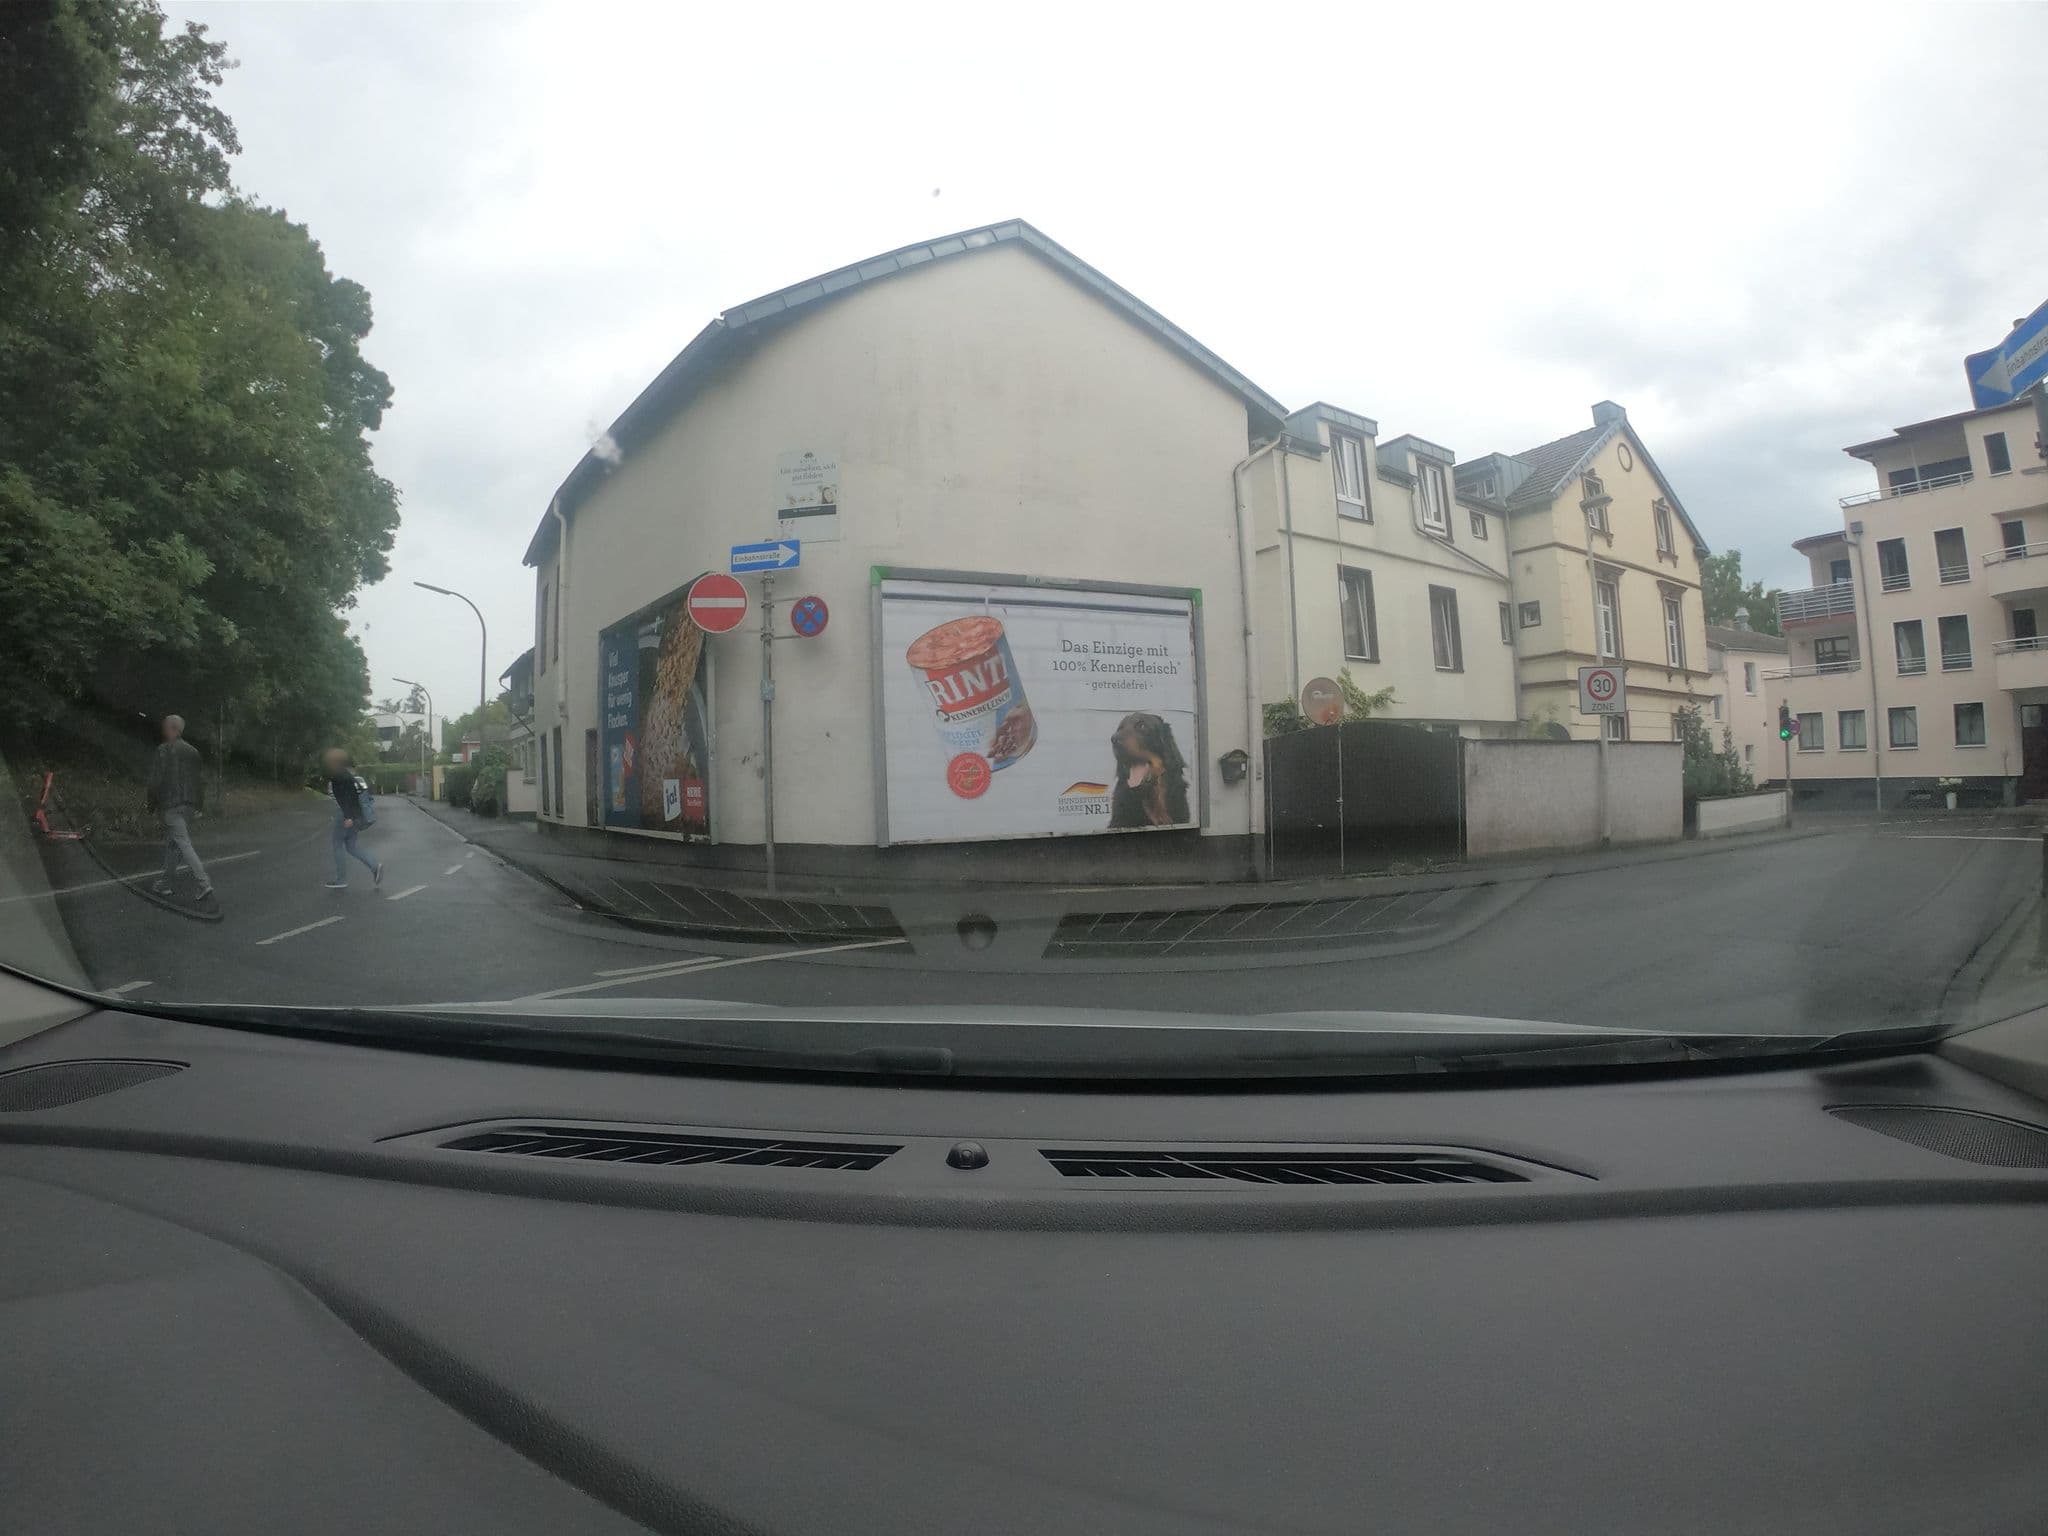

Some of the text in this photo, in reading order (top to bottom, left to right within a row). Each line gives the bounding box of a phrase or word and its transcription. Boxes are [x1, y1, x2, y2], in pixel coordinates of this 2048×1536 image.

[735, 552, 780, 563] Einbahnstraße
[1061, 639, 1169, 658] Das Einzige mit
[1053, 660, 1087, 672] 100%
[924, 653, 1009, 707] RINTI
[1091, 679, 1148, 690] getreidefrei
[1593, 679, 1611, 693] 30
[951, 692, 1011, 722] KENNERFLEISCH
[1591, 703, 1615, 711] ZONE
[686, 786, 702, 798] REWE
[665, 784, 678, 815] ja!
[1085, 803, 1110, 815] NR.1
